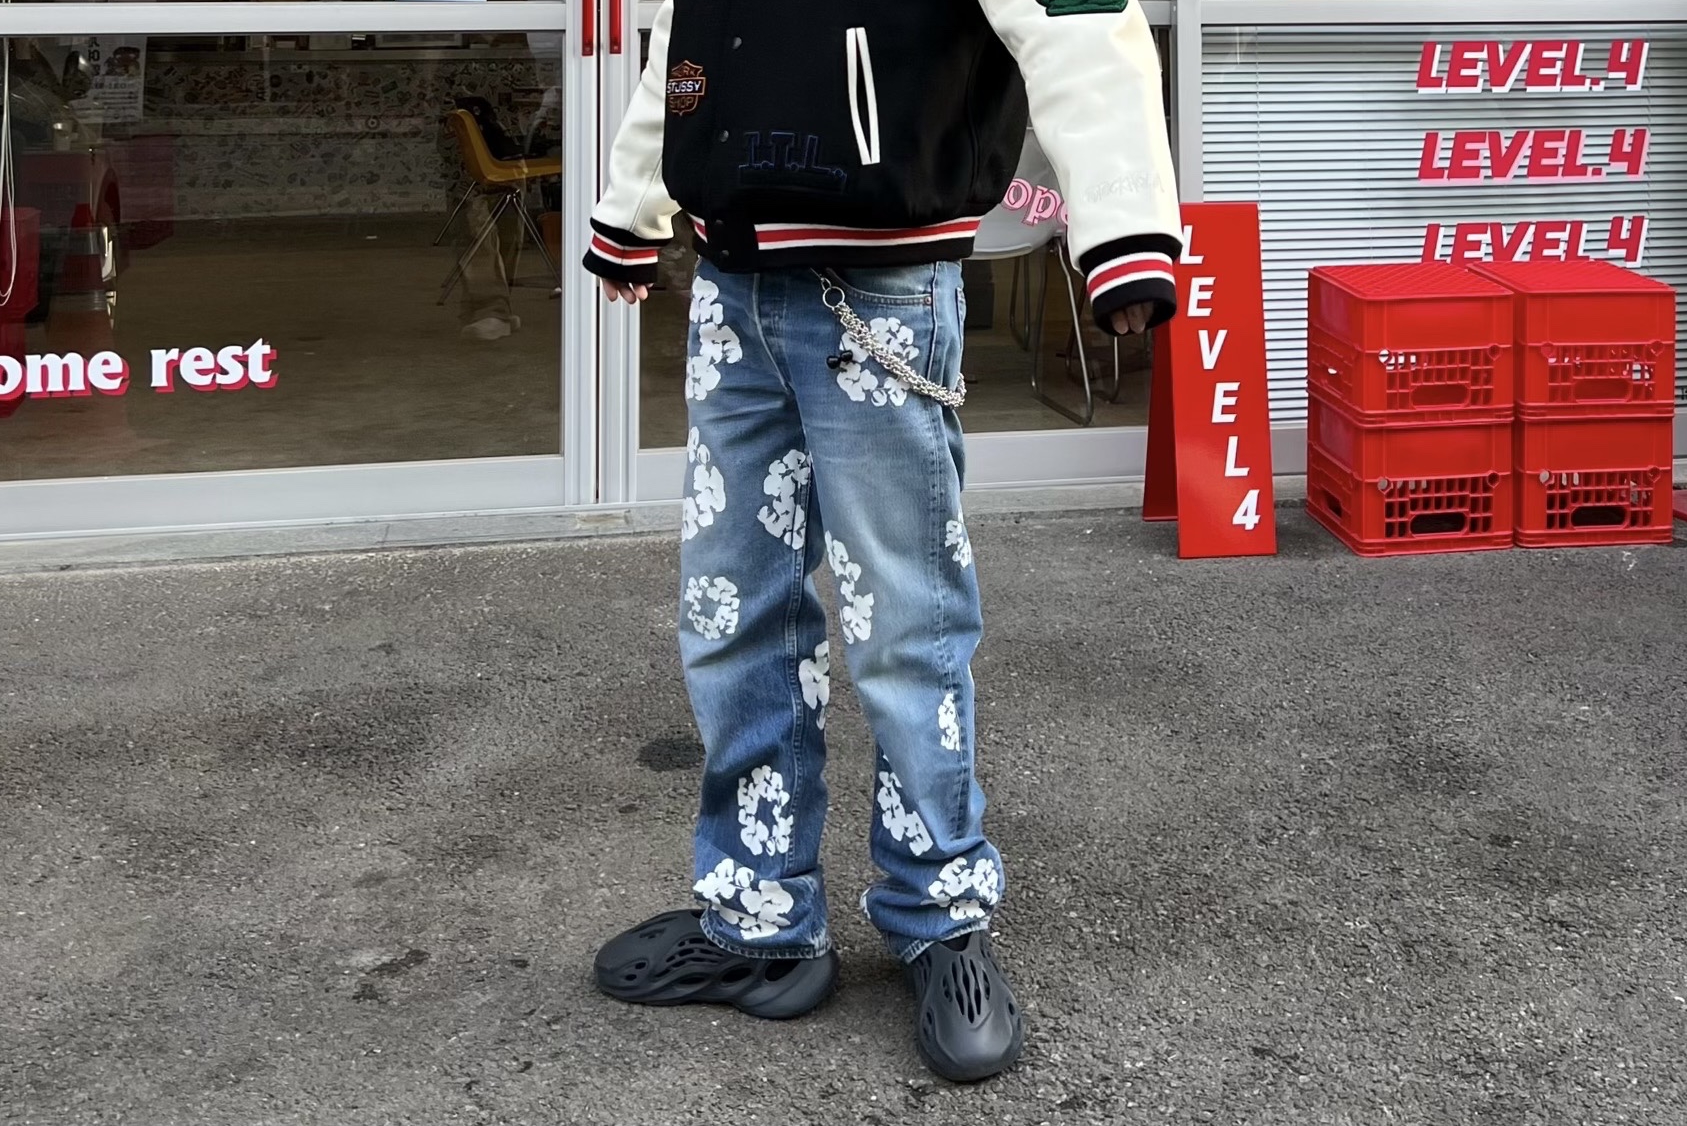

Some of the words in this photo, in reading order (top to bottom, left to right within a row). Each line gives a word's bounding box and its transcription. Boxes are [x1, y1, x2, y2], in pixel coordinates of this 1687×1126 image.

[1416, 38, 1650, 94] LEVEL.4
[1417, 128, 1649, 185] LEVEL.4
[150, 338, 279, 393] rest
